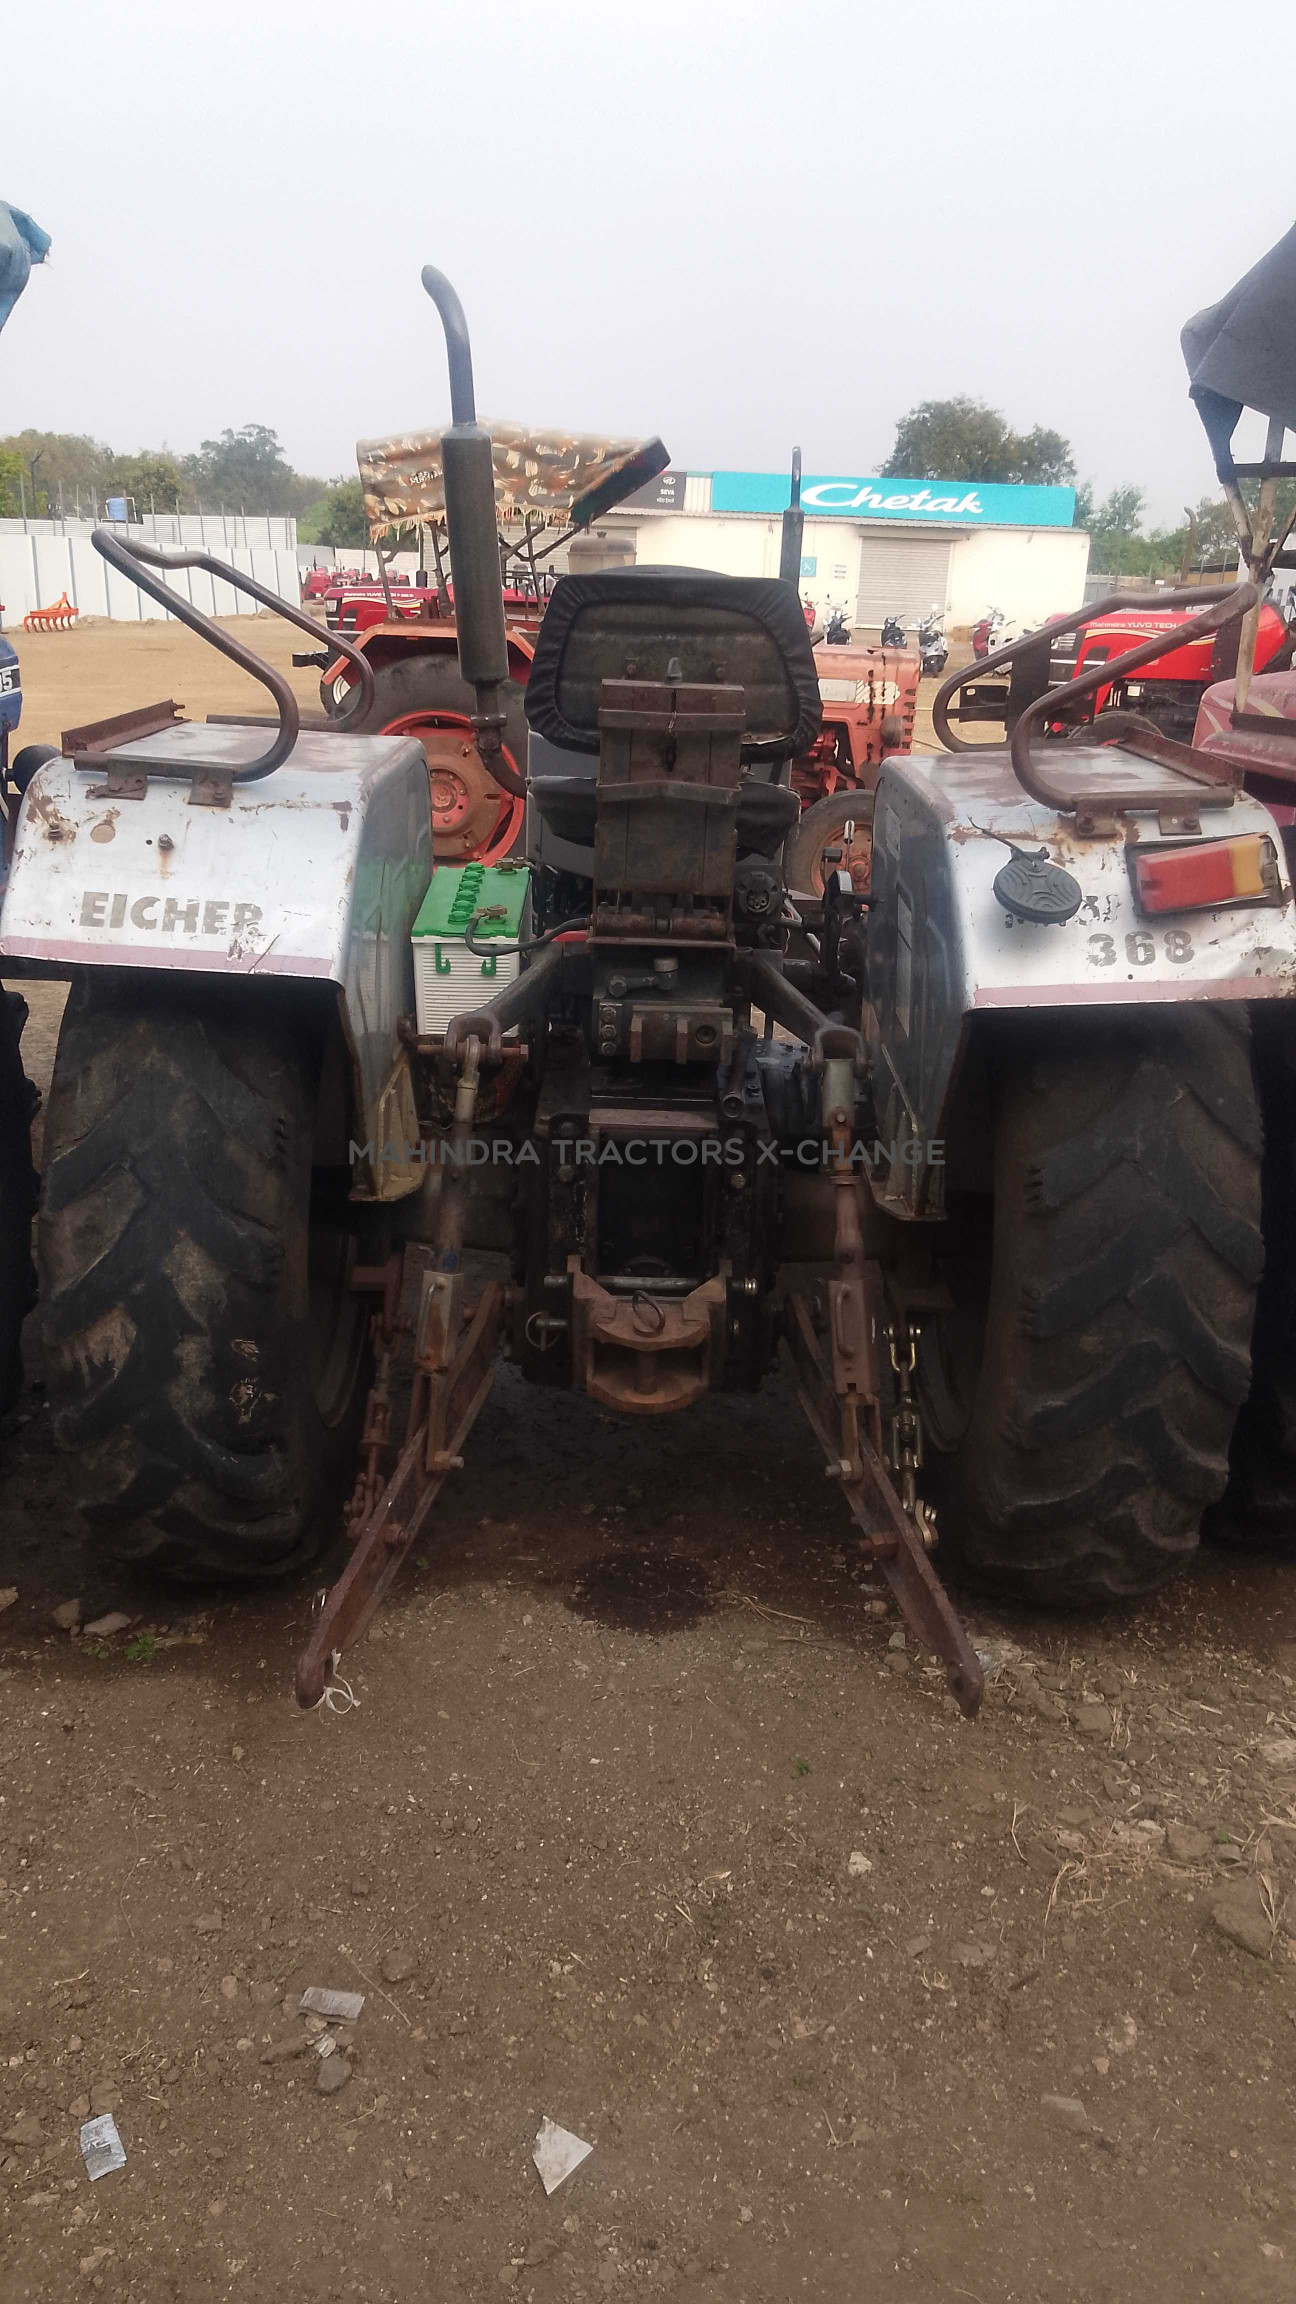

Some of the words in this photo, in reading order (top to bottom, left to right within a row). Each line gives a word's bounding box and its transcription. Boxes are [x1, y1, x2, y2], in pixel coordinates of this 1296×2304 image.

[800, 483, 984, 514] Chetak
[79, 890, 264, 936] EICHER
[1086, 930, 1195, 968] 368
